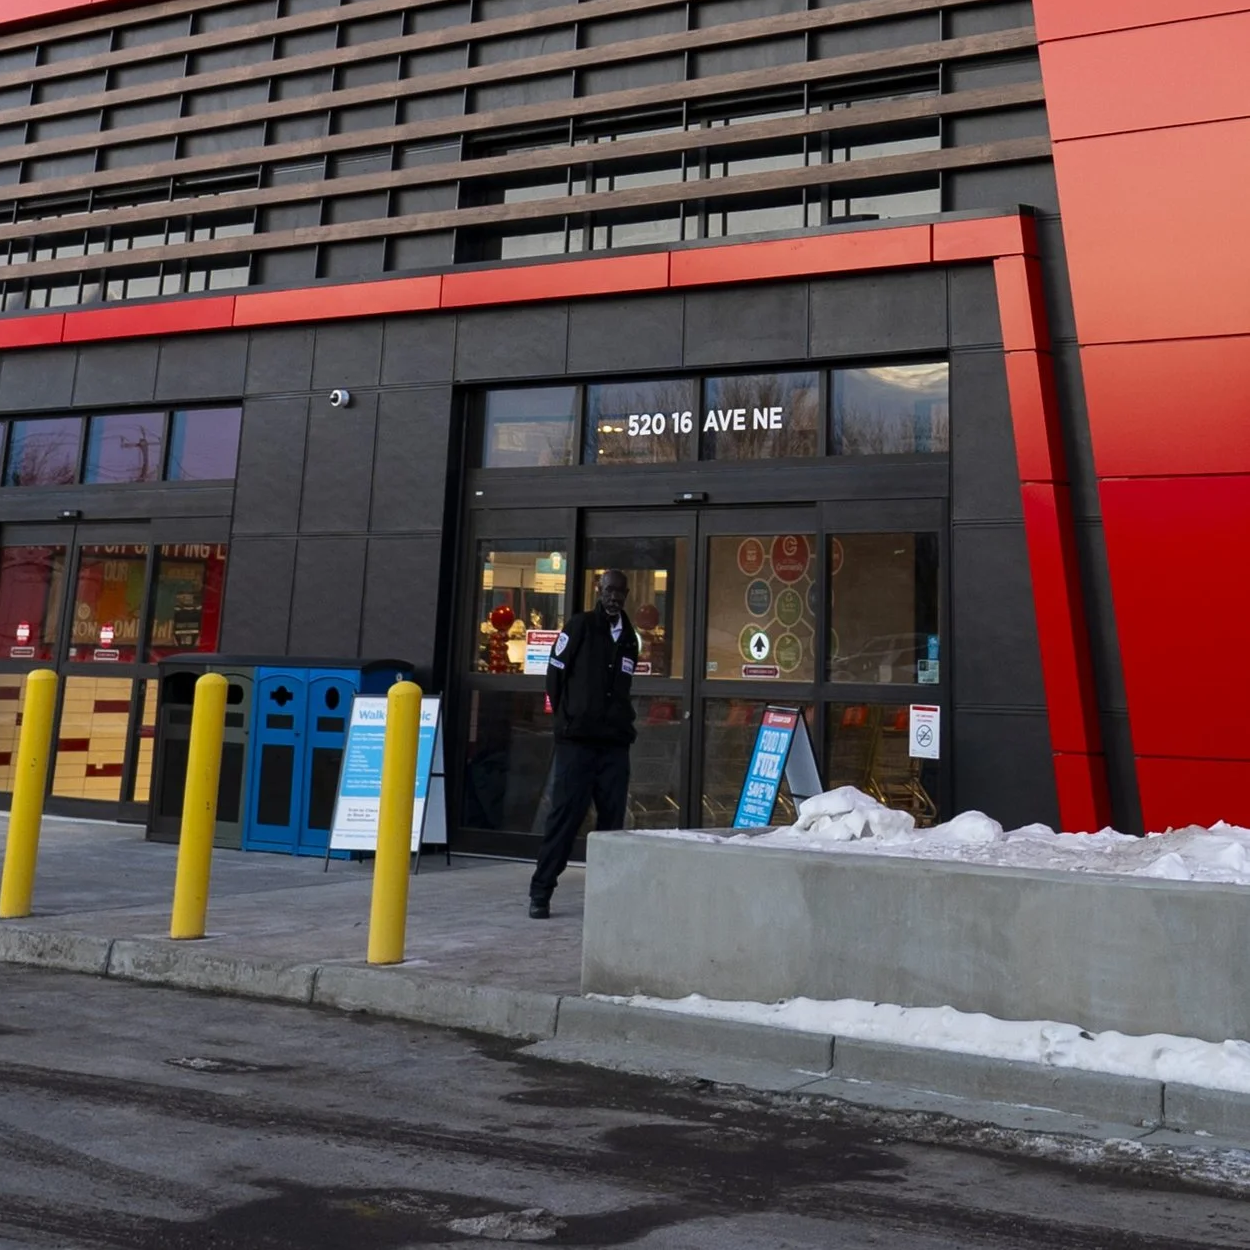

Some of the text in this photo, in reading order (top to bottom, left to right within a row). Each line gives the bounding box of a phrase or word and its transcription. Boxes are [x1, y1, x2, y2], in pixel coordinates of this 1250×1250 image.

[628, 407, 783, 436] 520 16 AVE NE
